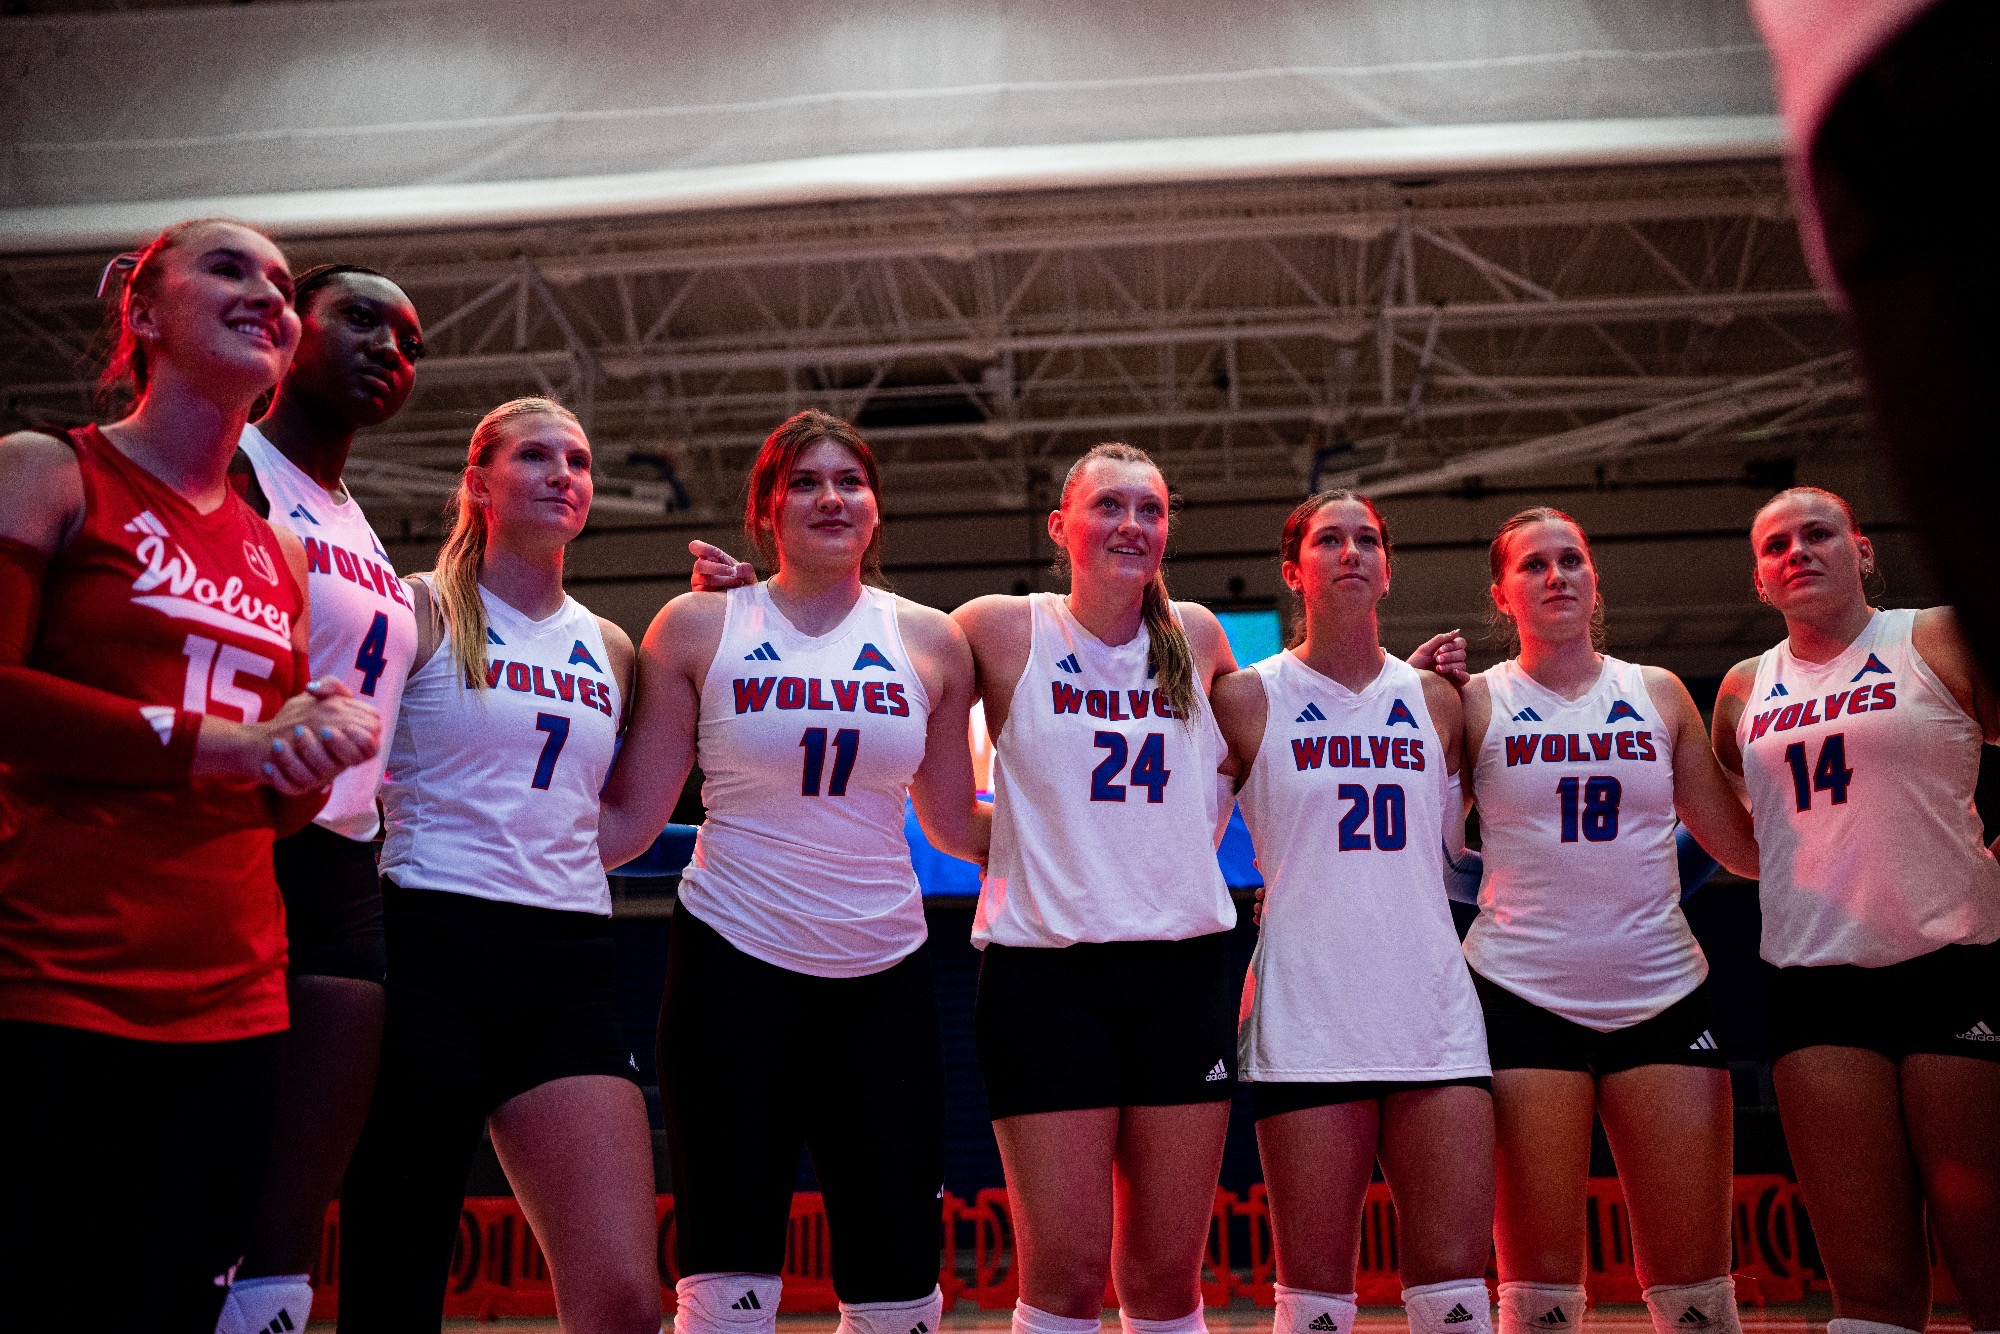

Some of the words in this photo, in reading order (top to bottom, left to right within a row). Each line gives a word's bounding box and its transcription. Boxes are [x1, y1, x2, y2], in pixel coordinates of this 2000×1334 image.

[132, 535, 291, 641] Wolves
[182, 633, 275, 726] 15
[355, 611, 388, 697] 4
[732, 676, 910, 717] WOLVES
[1052, 681, 1189, 723] WOLVE
[1748, 681, 1897, 745] WOLVES
[531, 711, 571, 791] 7
[799, 727, 860, 797] 11
[1090, 731, 1171, 804] 24
[1291, 736, 1426, 772] WOLVES
[1505, 731, 1657, 768] WOLVES
[1784, 732, 1854, 814] 14
[1338, 784, 1407, 852] 20
[1555, 776, 1623, 843] 18
